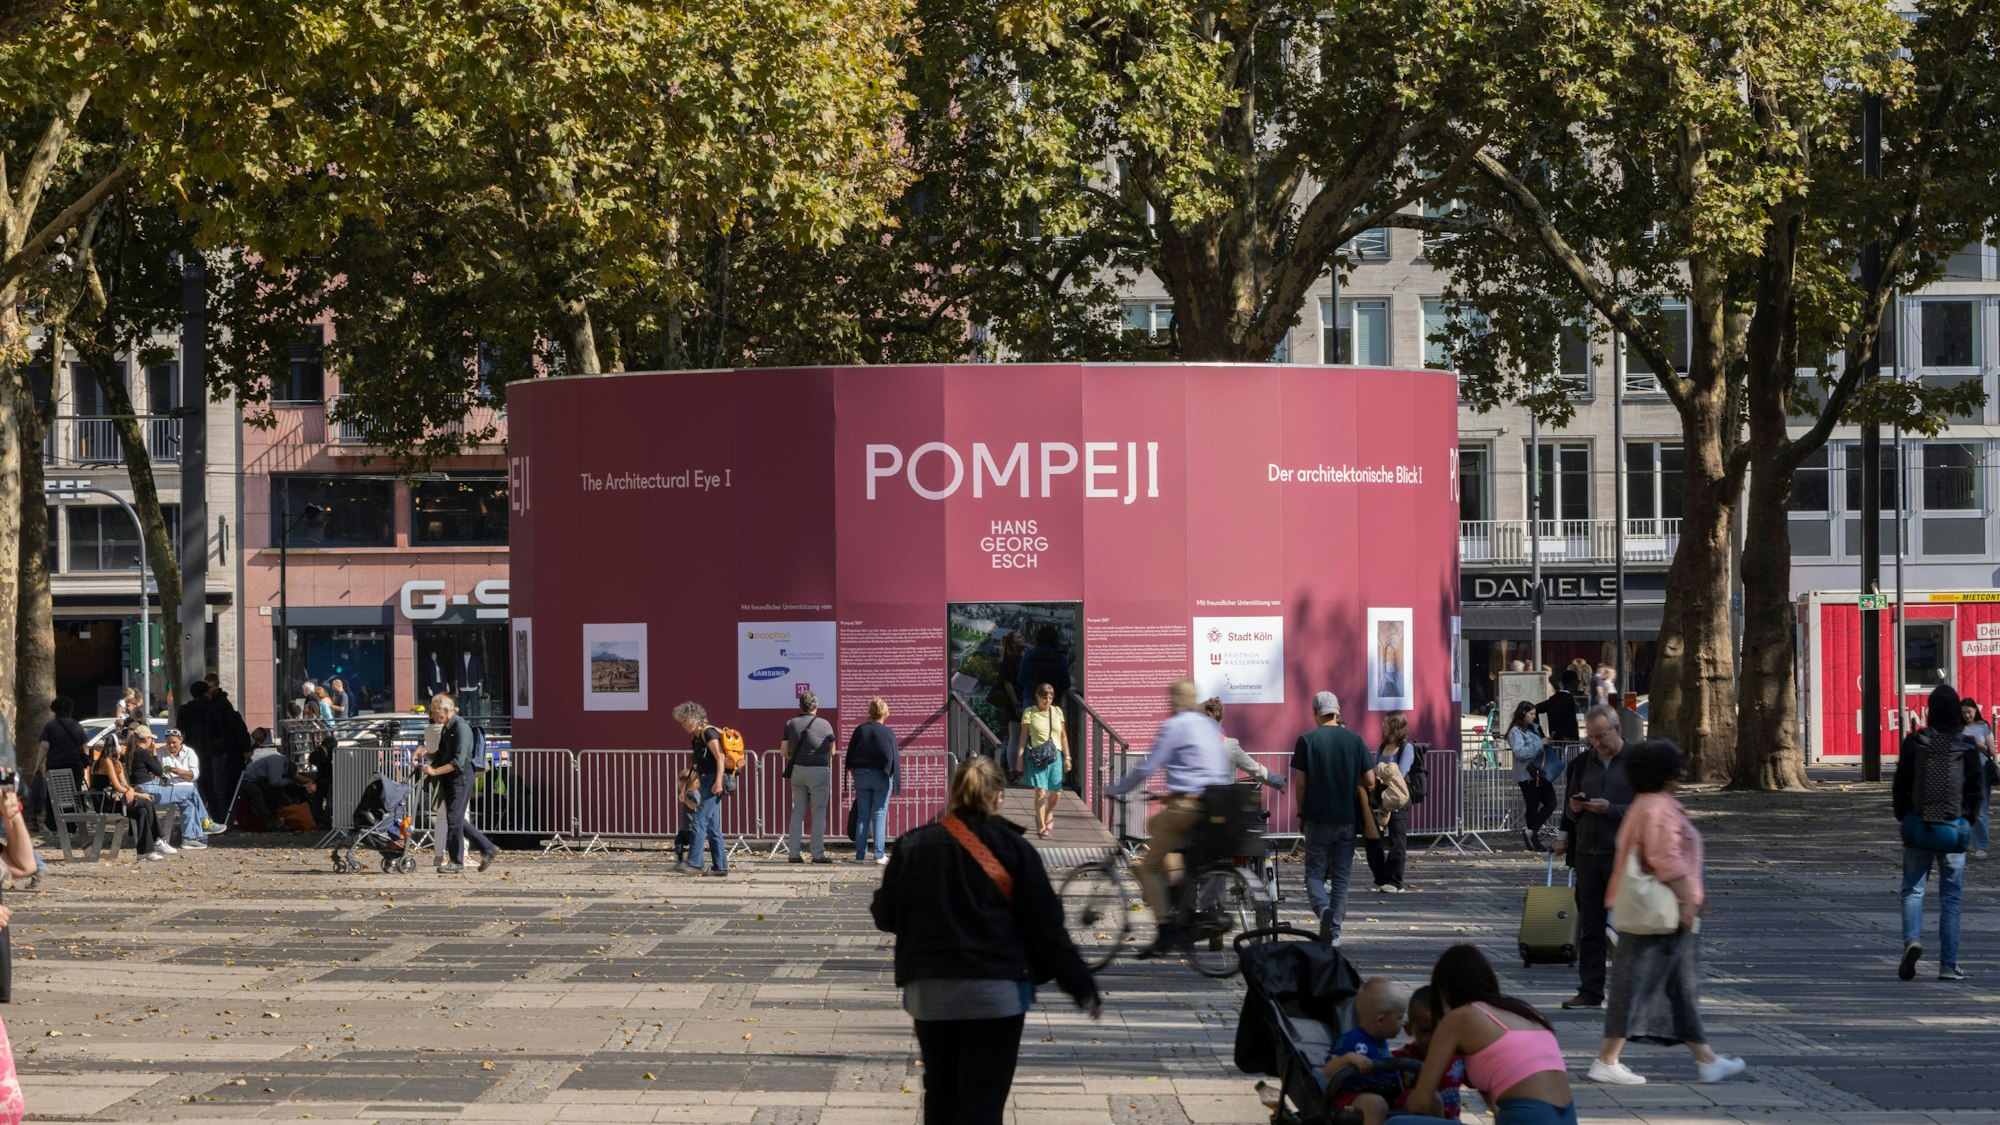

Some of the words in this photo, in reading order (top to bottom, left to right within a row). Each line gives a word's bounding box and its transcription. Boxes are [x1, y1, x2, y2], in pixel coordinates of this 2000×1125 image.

[580, 473, 602, 491] The
[605, 470, 690, 490] Architectural
[694, 470, 721, 492] Eye
[725, 469, 731, 487] I
[865, 441, 1159, 505] POMPEJI
[1268, 463, 1294, 482] Der
[1297, 464, 1394, 484] architektonische
[1396, 465, 1418, 484] Blick
[508, 456, 530, 517] EJI
[991, 520, 1038, 535] HANS
[980, 536, 1049, 552] GEORG
[992, 553, 1038, 569] ESCH
[751, 603, 782, 611] freundlicher
[782, 603, 820, 611] Unterstützung
[1237, 599, 1271, 607] Unterstützung
[754, 631, 791, 640] ecophon
[1228, 632, 1252, 642] Stadt
[1253, 631, 1273, 641] Köln
[1230, 682, 1262, 690] koelnmesse
